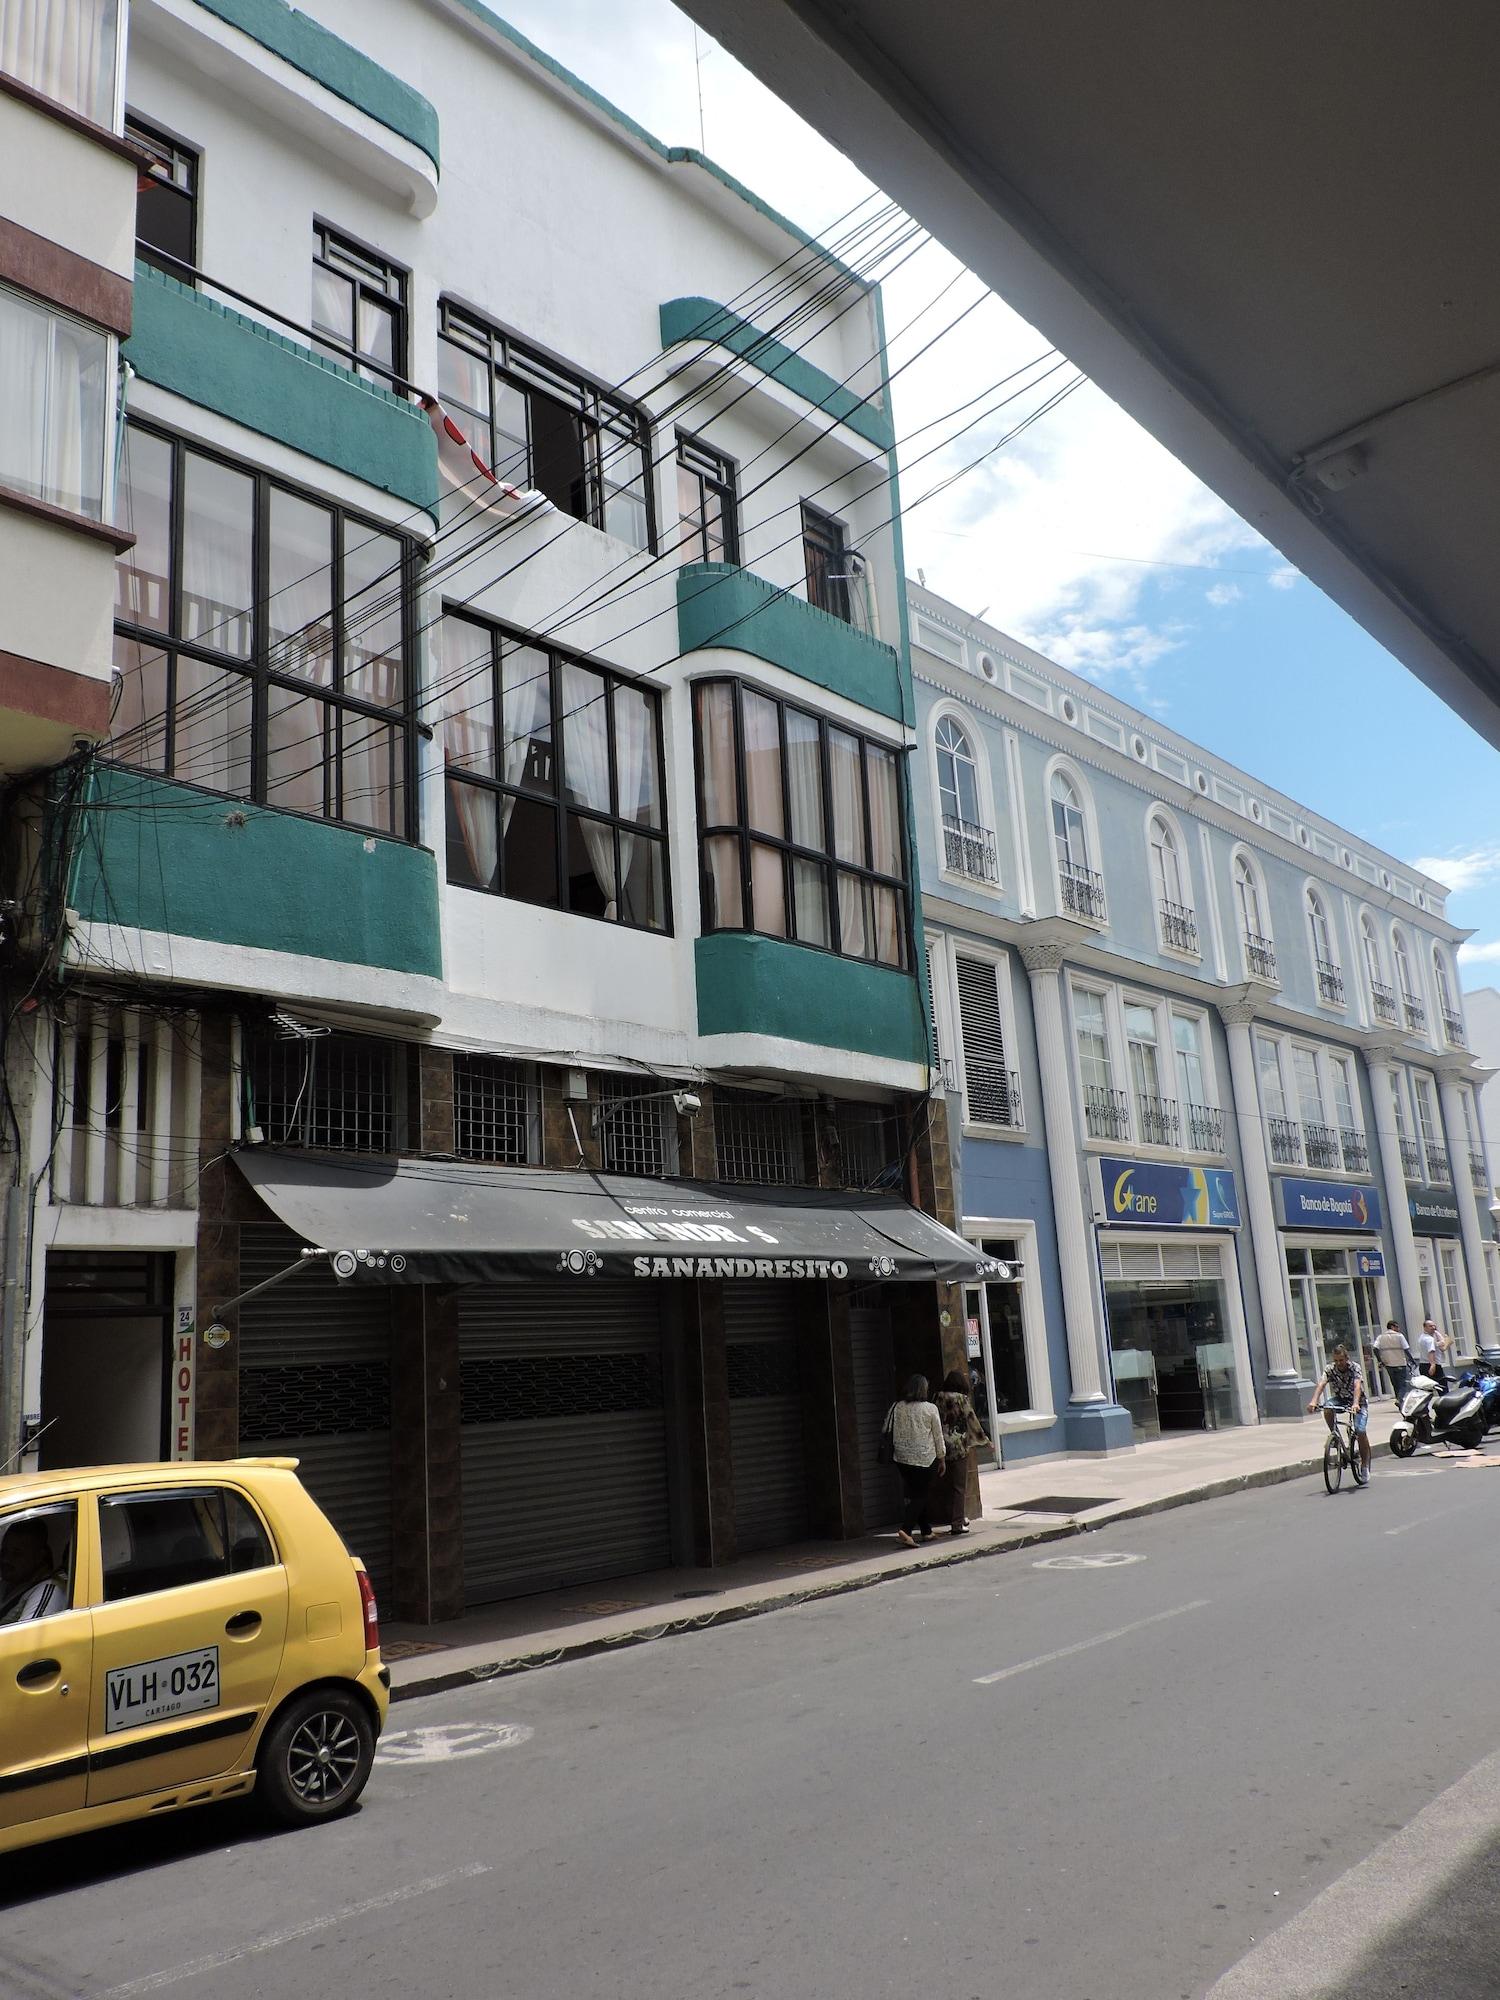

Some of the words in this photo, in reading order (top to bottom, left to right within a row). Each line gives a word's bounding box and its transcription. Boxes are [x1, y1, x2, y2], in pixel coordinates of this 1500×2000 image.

[624, 1205, 668, 1216] centro
[672, 1207, 735, 1220] comercial
[1300, 1194, 1321, 1210] Banco
[1321, 1196, 1330, 1211] de
[1329, 1197, 1353, 1216] Bogotá
[1416, 1202, 1430, 1216] Banco
[1430, 1204, 1436, 1217] de
[633, 1256, 849, 1279] SANANDRESITO
[180, 1311, 190, 1321] 24
[178, 1337, 191, 1461] HOTE
[110, 1672, 157, 1711] VLH
[171, 1659, 216, 1696] 032
[145, 1702, 181, 1717] CARTAGO
